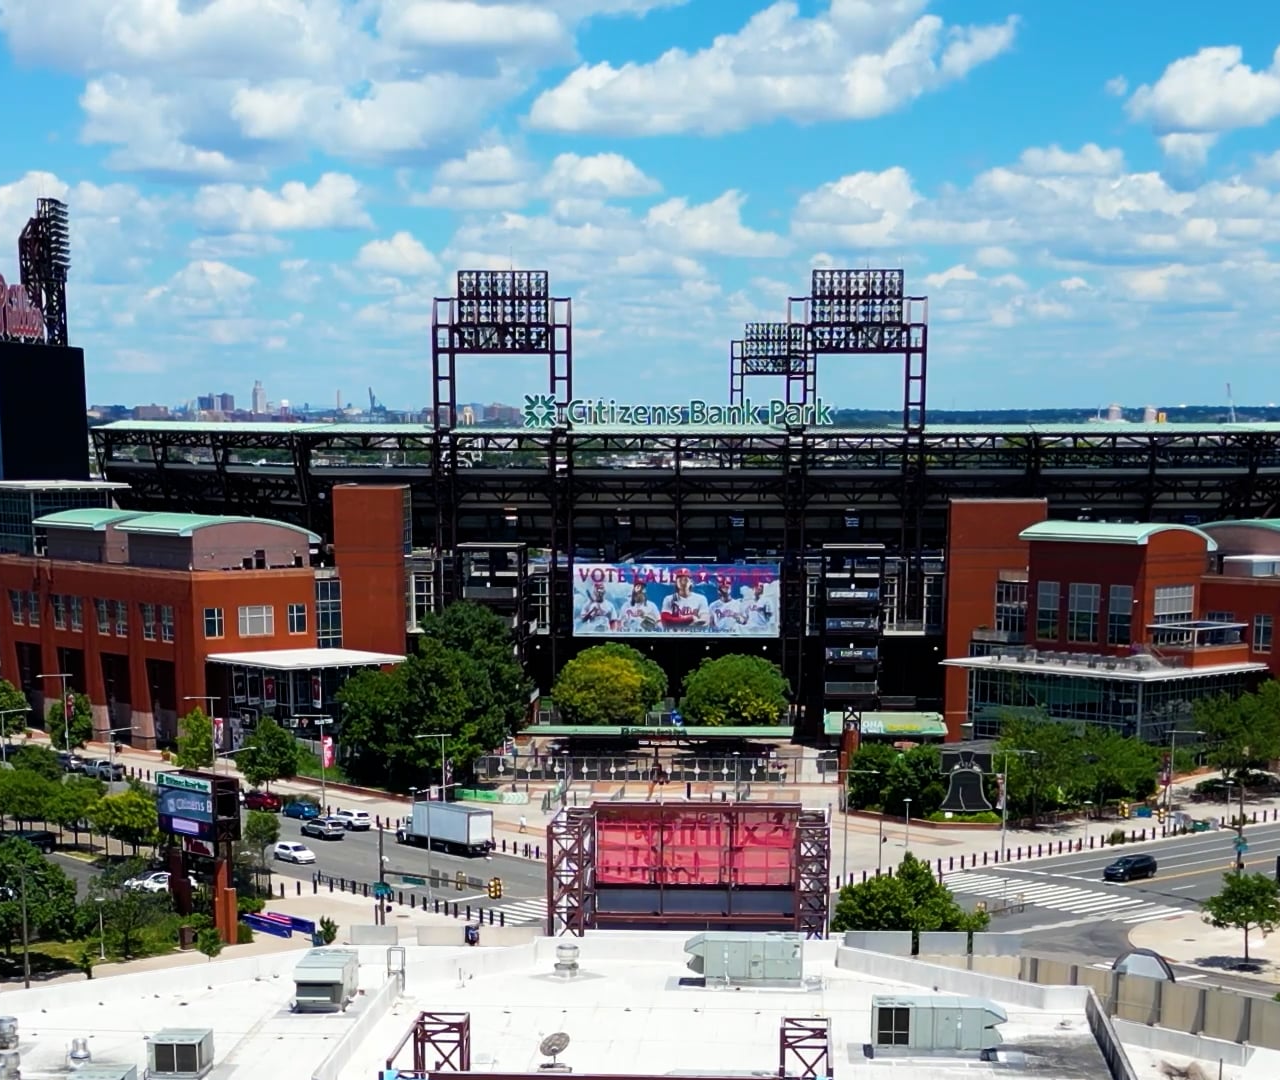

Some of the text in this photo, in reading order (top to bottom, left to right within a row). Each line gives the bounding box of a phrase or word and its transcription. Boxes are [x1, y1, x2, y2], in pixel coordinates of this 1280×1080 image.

[568, 397, 834, 425] Citizens Bank Park
[579, 568, 626, 583] VOTE
